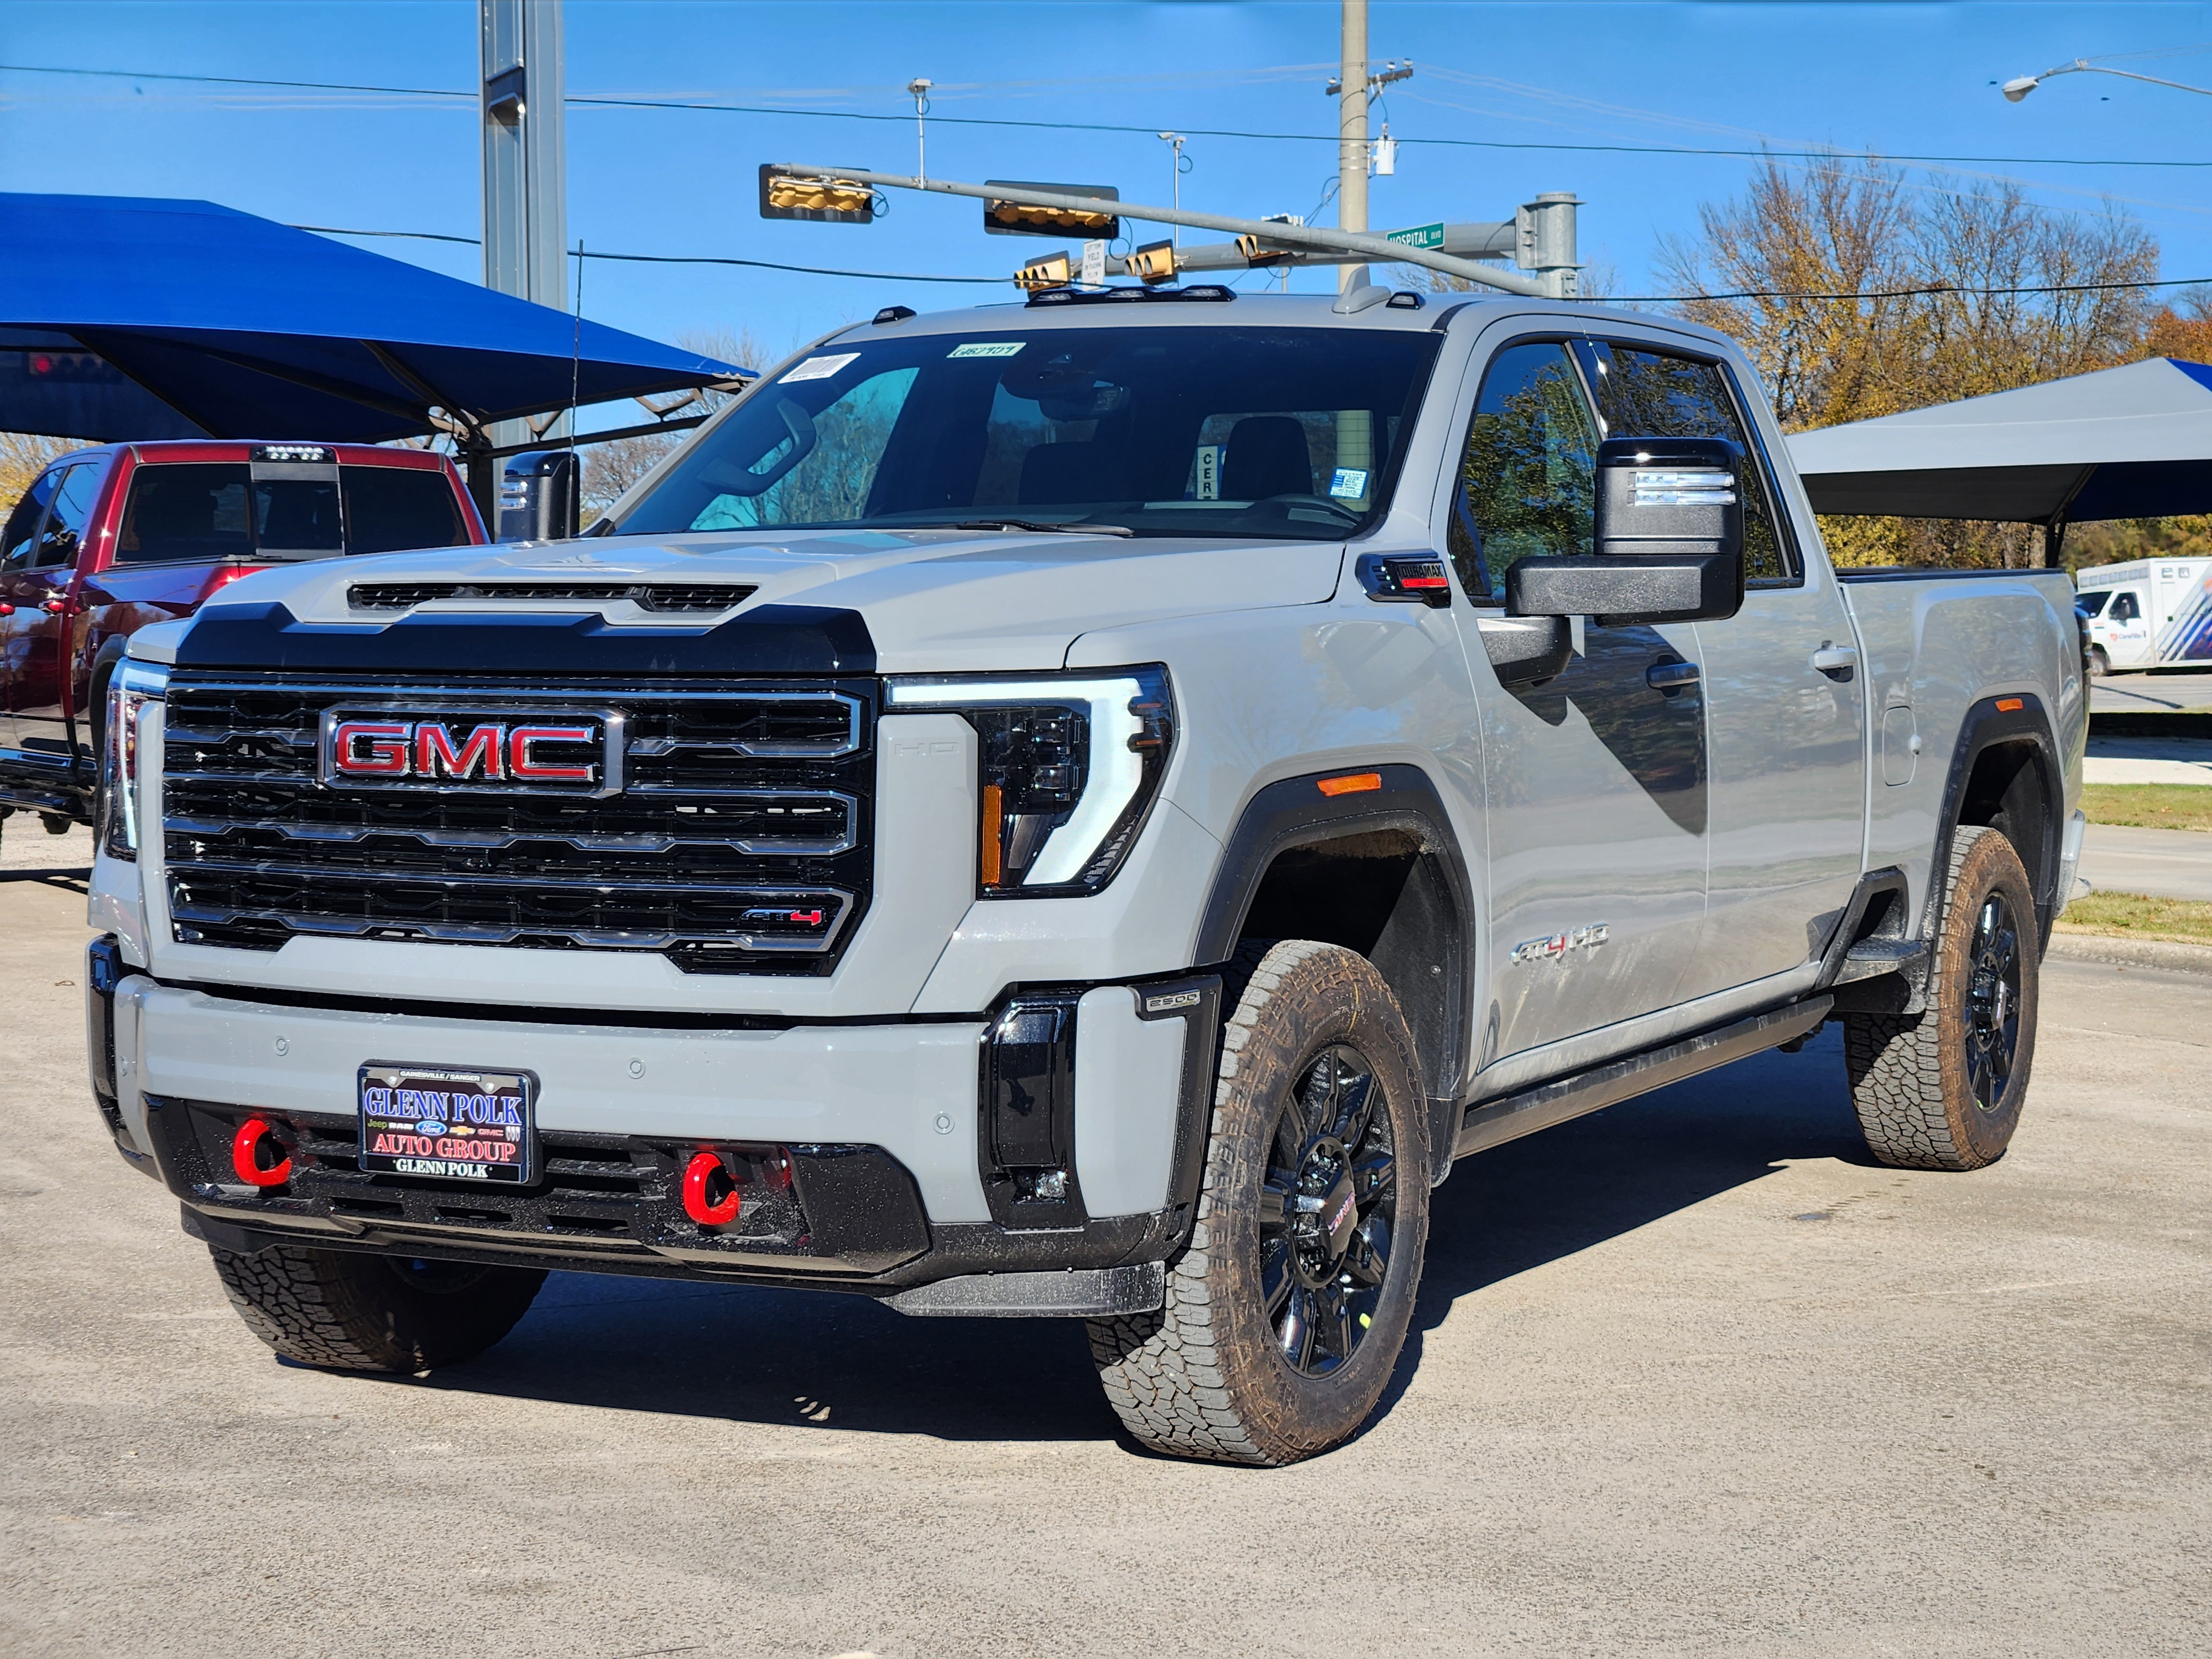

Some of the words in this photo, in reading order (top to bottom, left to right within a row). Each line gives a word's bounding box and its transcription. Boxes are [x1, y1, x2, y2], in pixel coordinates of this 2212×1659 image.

[1203, 453, 1212, 498] CER
[1401, 565, 1443, 577] DURAMAX
[336, 721, 594, 782] GMC
[1150, 994, 1197, 1006] 2500
[400, 1071, 445, 1079] GAINESVILLE
[364, 1087, 449, 1121] GLENN
[452, 1093, 522, 1125] POLK
[367, 1119, 387, 1129] Jeep
[421, 1123, 441, 1134] Ford
[478, 1128, 504, 1136] GMC
[373, 1134, 432, 1155] AUTO
[436, 1138, 516, 1162] GROUP
[395, 1159, 448, 1175] GLENN
[448, 1162, 489, 1178] POLK
